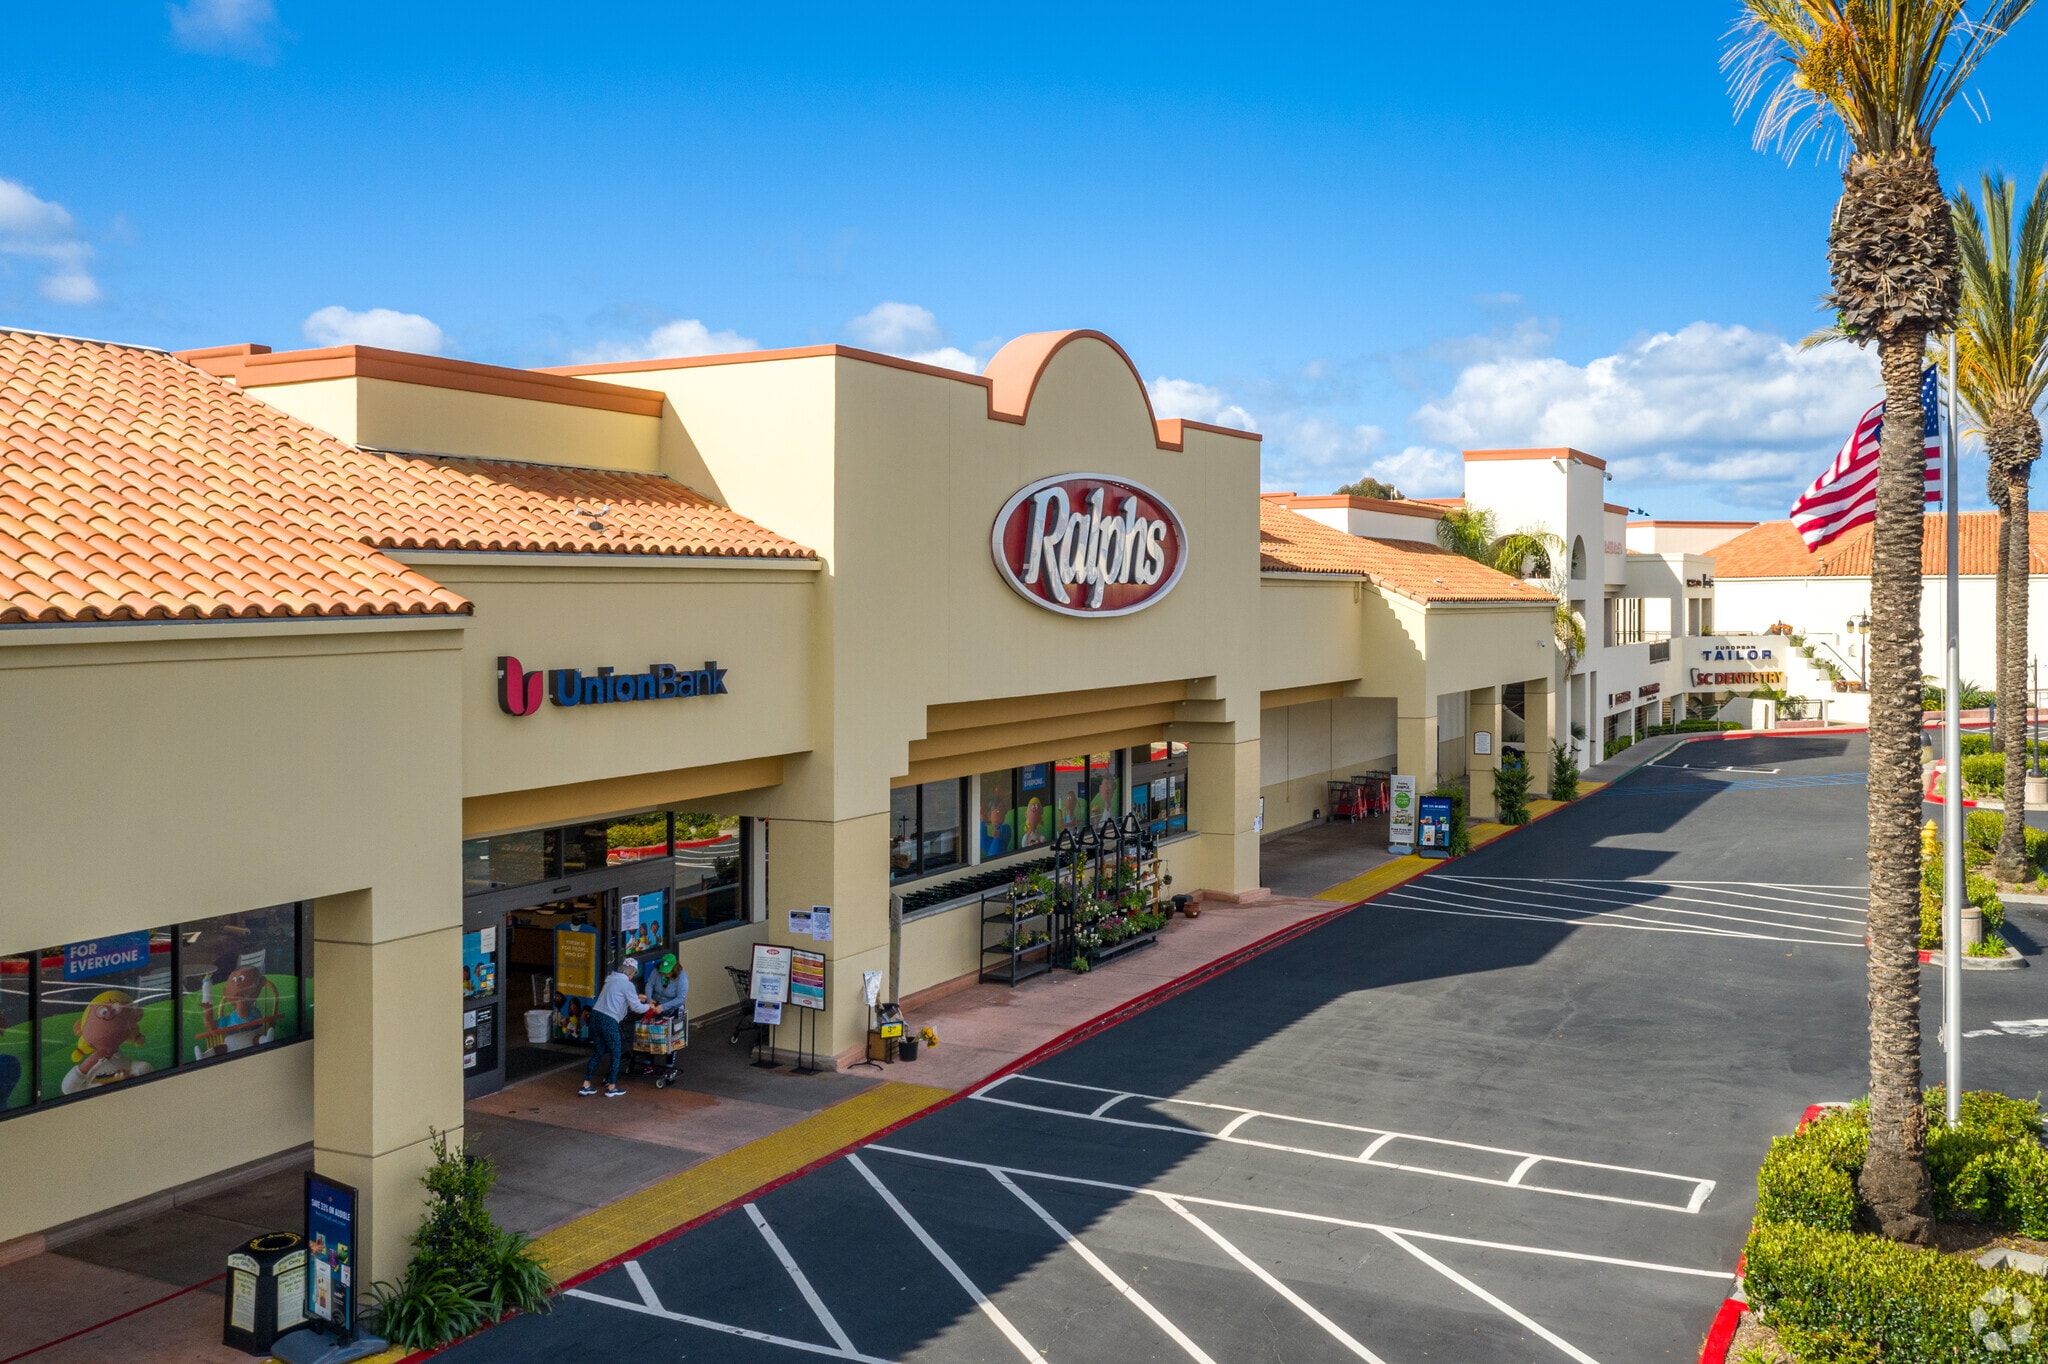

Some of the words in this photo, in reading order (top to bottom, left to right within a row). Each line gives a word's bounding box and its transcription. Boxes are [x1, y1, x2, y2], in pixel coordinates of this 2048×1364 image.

[1020, 487, 1167, 608] Ralphs
[1703, 650, 1772, 661] TAILOR
[549, 661, 728, 707] UnionBank
[1696, 672, 1713, 686] SC
[1715, 671, 1784, 685] DENTISTRY
[70, 943, 98, 959] FOR
[70, 949, 138, 974] EVERYONE
[311, 1198, 321, 1209] SAVE
[334, 1208, 351, 1222] AUDIBLE
